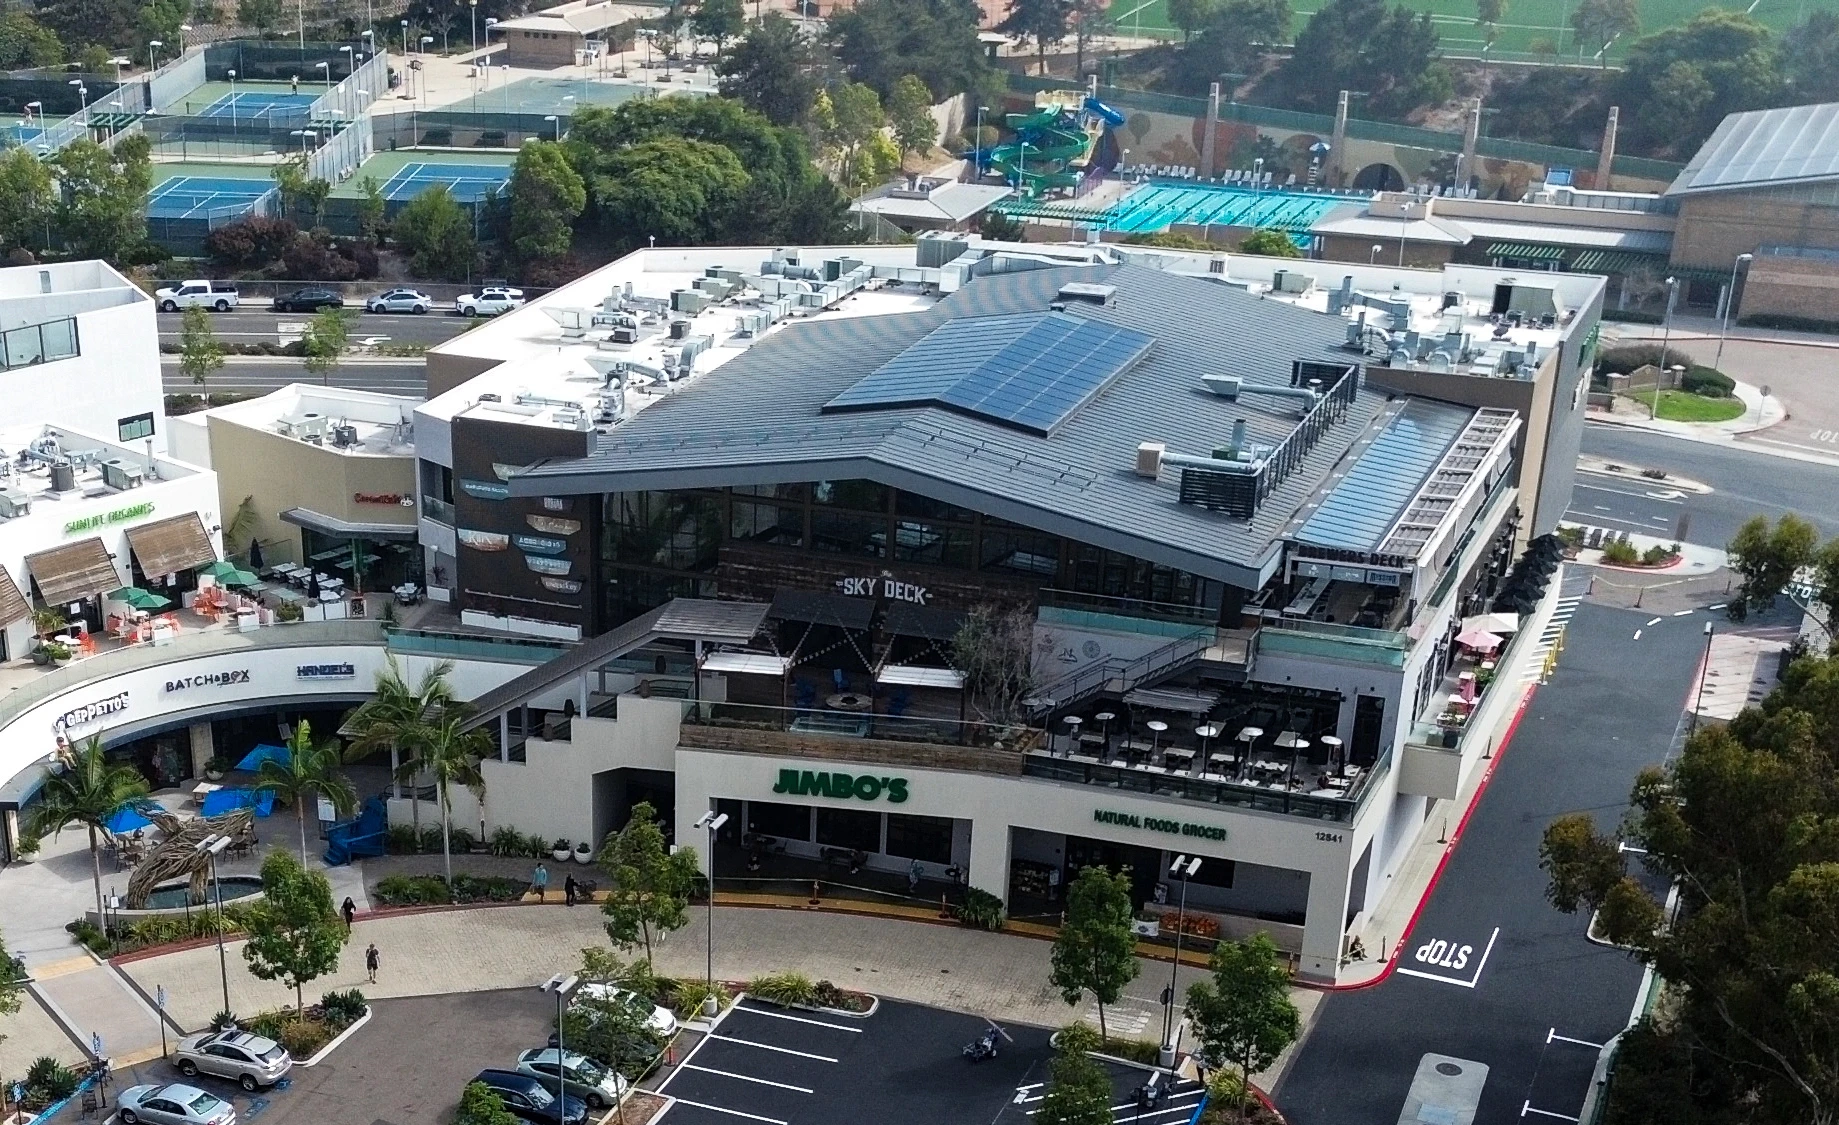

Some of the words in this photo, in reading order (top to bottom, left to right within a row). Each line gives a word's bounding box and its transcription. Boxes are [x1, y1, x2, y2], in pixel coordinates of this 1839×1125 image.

[1369, 553, 1404, 568] DECK
[844, 578, 877, 596] SKY
[884, 580, 926, 605] DECK
[166, 673, 214, 692] BATCH
[221, 669, 250, 682] BOX
[773, 769, 908, 803] JIMBO'S
[1093, 809, 1141, 829] NATURAL
[1144, 817, 1180, 834] FOODS
[1182, 823, 1227, 841] GROCER
[1315, 832, 1343, 843] 12841
[1415, 938, 1473, 970] STOP
